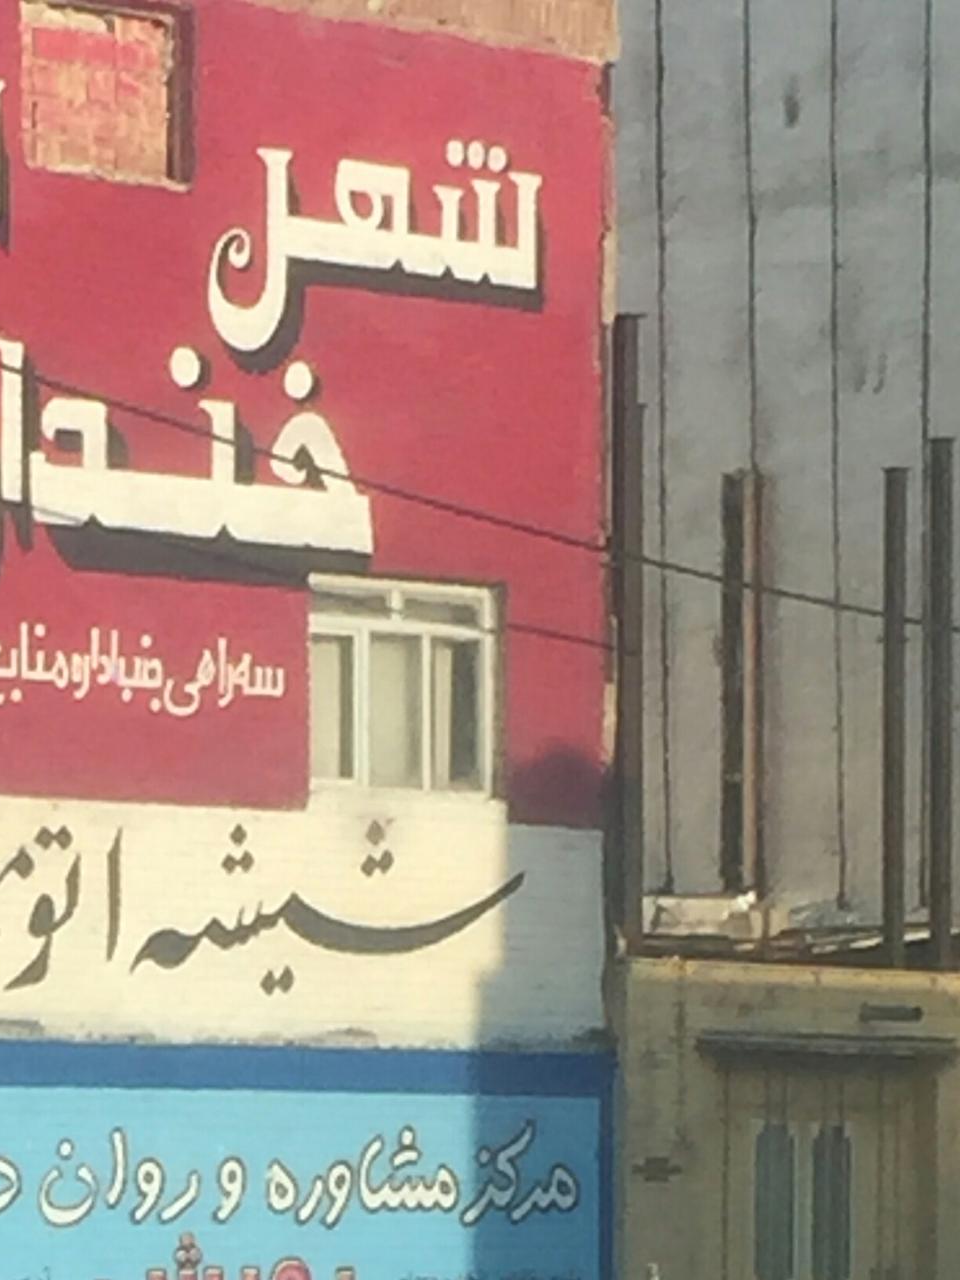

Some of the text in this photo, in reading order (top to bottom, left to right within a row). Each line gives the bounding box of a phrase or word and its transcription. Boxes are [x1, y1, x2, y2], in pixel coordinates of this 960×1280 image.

[208, 138, 542, 352] شهر
[128, 818, 527, 996] شیشه
[39, 1125, 201, 1228] روان
[212, 1156, 248, 1225] و
[266, 1124, 460, 1229] مشاوره
[459, 1117, 581, 1229] مرکز
